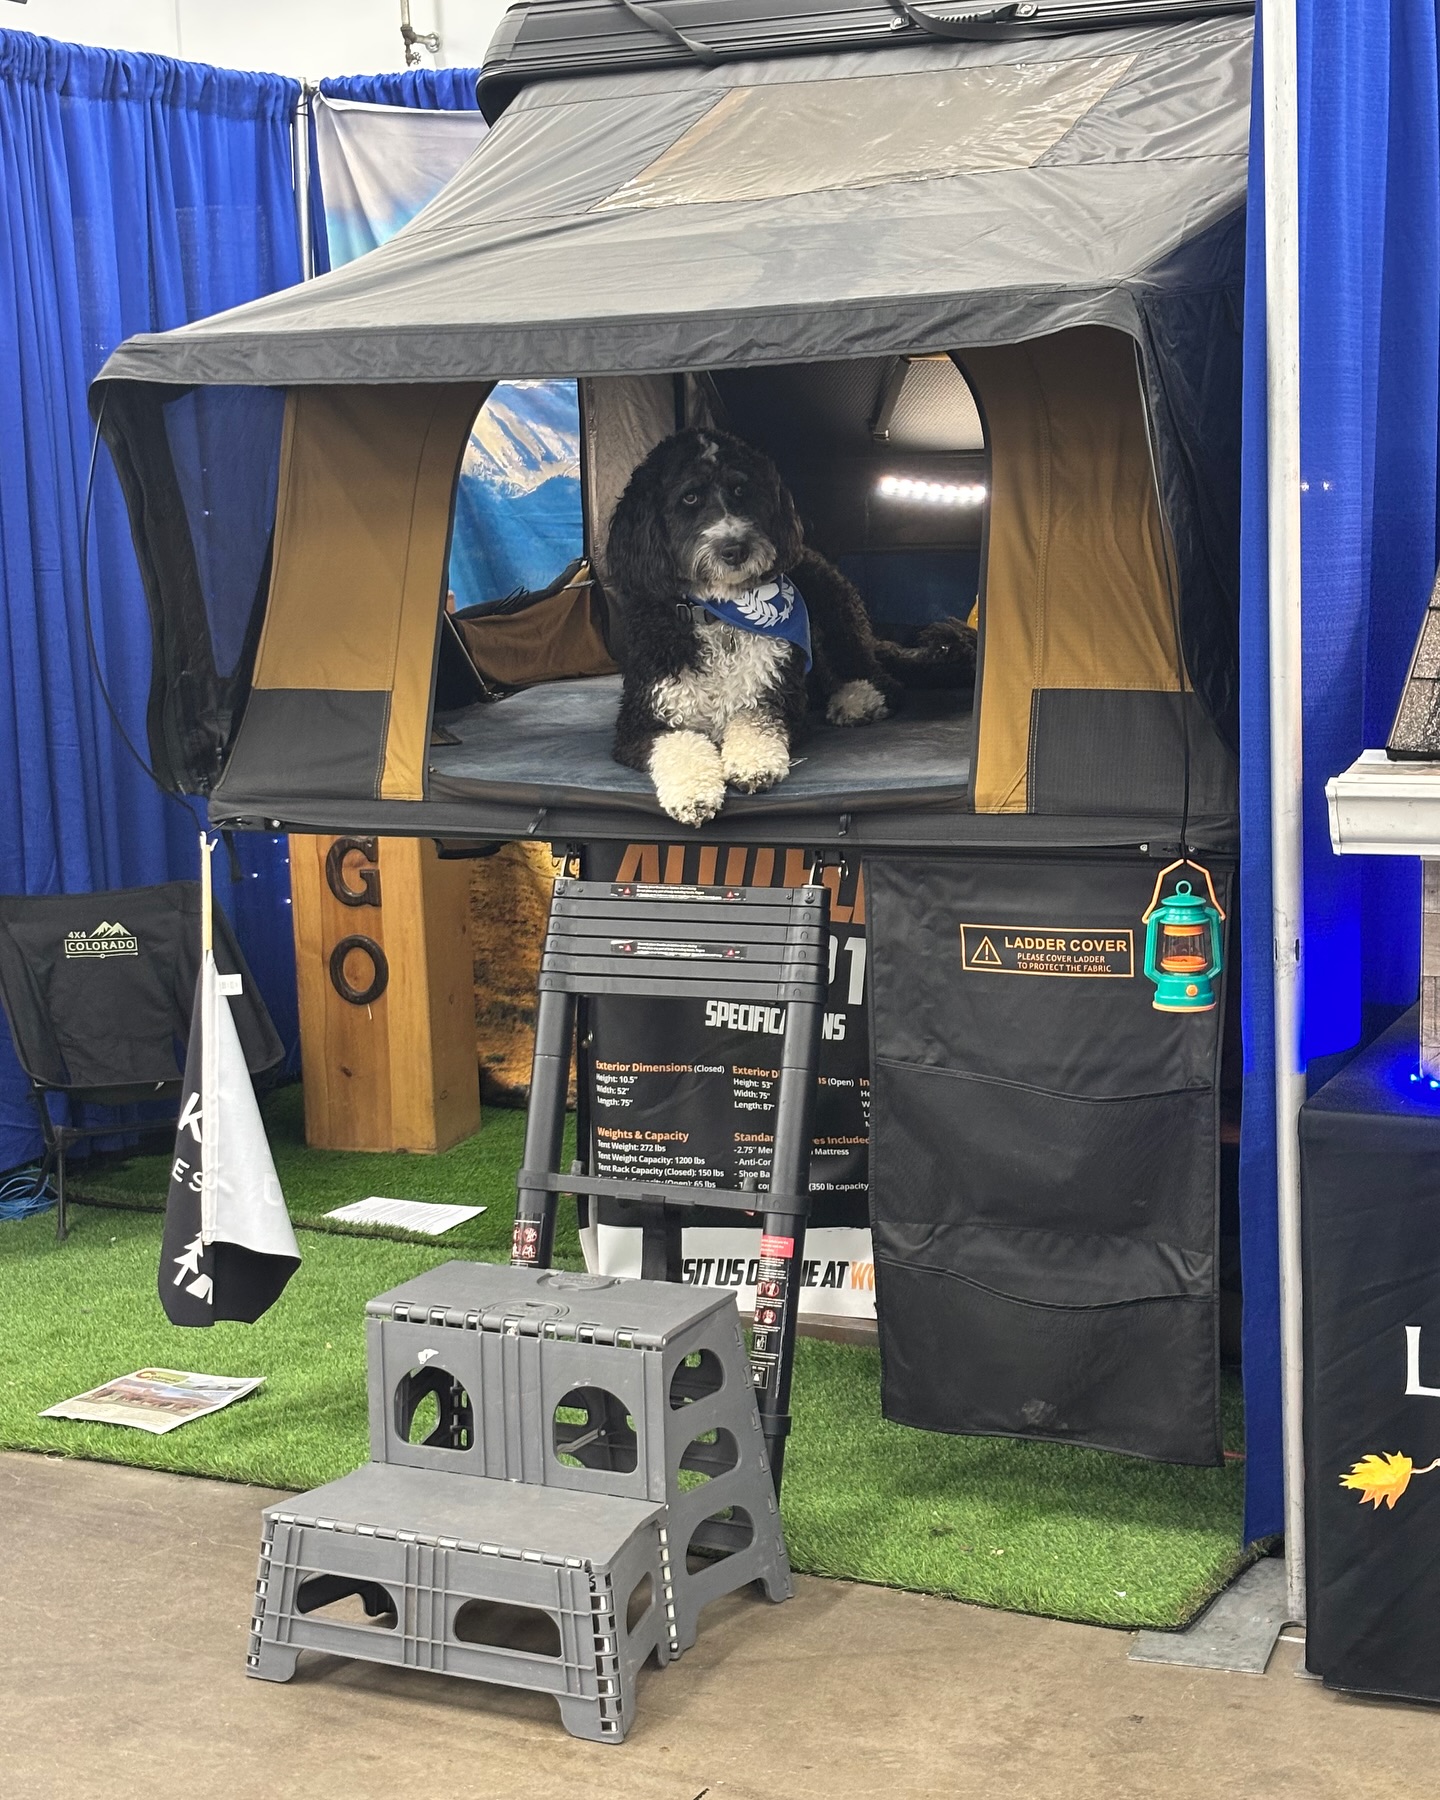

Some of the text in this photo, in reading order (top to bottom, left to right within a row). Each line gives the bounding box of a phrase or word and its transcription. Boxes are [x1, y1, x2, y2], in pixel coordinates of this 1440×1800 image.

[68, 940, 135, 951] COLORADO
[1004, 936, 1127, 952] LADDER COVER
[1017, 952, 1105, 963] PLEASE COVER LADDER
[1017, 961, 1028, 969] TO
[1029, 963, 1064, 971] PROTECT
[1066, 964, 1081, 972] THE
[595, 1060, 725, 1074] Exterior Dimensions (Closed)
[732, 1065, 770, 1077] Exterior
[596, 1073, 618, 1084] Height:
[733, 1078, 759, 1088] Height:
[828, 1077, 855, 1087] (Open)
[734, 1089, 758, 1098] Width:
[597, 1096, 620, 1107] Length:
[734, 1100, 762, 1111] Length:
[597, 1126, 690, 1142] Weights & Capacity
[734, 1132, 774, 1142] Standar
[597, 1139, 610, 1149] Tent
[611, 1142, 640, 1152] Weight:
[640, 1144, 654, 1152] 272
[814, 1148, 850, 1156] Mattress
[597, 1151, 611, 1161] Tent
[611, 1153, 637, 1164] Weight
[638, 1155, 674, 1166] Capacity:
[694, 1157, 706, 1165] lbs
[597, 1162, 611, 1172] Tent
[612, 1165, 630, 1173] Rack
[631, 1166, 664, 1177] Capacity
[664, 1168, 697, 1178] (Closed):
[713, 1169, 725, 1177] lbs
[738, 1170, 758, 1178] Shoe
[704, 1181, 716, 1189] lbs
[808, 1182, 825, 1192] (350
[826, 1182, 834, 1190] lb
[715, 1258, 745, 1286] US
[820, 1260, 850, 1289] AT
